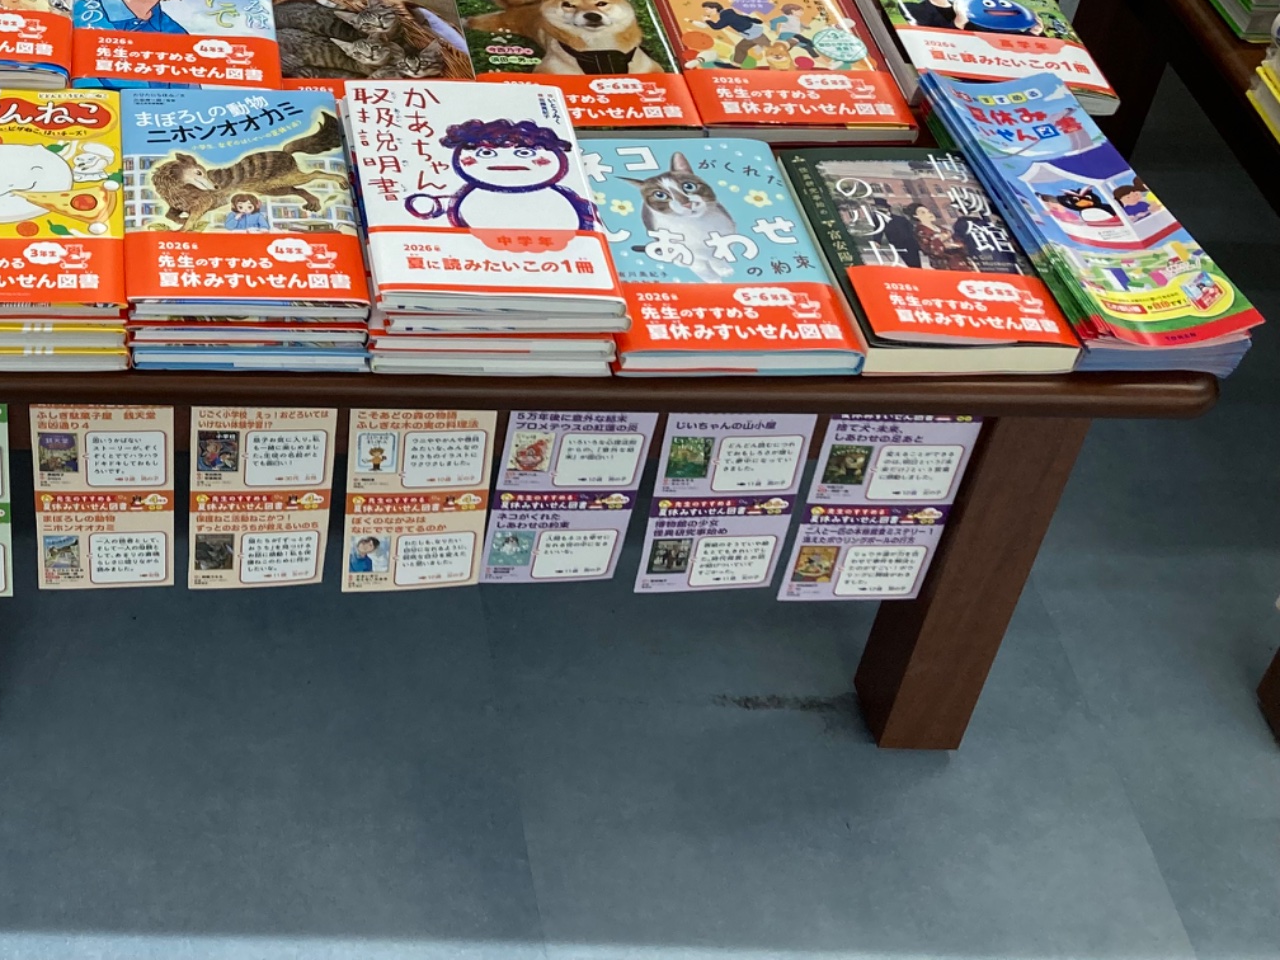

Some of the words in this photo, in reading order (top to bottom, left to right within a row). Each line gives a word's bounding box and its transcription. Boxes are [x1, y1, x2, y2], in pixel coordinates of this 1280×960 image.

[997, 39, 1049, 50] 高学年
[96, 46, 198, 63] 先生のすすめる
[930, 50, 1090, 74] 夏に読みたいこの1冊
[95, 60, 264, 82] 夏休みすいせん図書
[716, 87, 821, 100] 先生のすすめる
[133, 96, 270, 129] まぼろしの動物
[722, 100, 895, 117] 夏休みすいせん図書
[146, 101, 304, 145] ニホンオオカミ
[353, 89, 403, 202] 取扱説明書
[403, 87, 449, 188] かあちゃん
[698, 159, 784, 187] がくれた
[928, 153, 1016, 253] 博物館
[836, 178, 908, 268] の少女
[403, 243, 442, 253] 2026年
[496, 235, 554, 248] 中学年
[158, 254, 274, 269] 先生のすすめる
[405, 256, 595, 275] 夏に読みたいこの1冊
[747, 255, 816, 276] の約束
[159, 271, 352, 290] 夏休みすいせん図書
[641, 305, 760, 320] 先生のすすめる
[889, 294, 982, 313] 先生のすすめる
[647, 321, 844, 341] 夏休みすいせん図書
[896, 309, 1061, 336] 夏休みすいせん図書
[675, 420, 778, 431] じいちゃんの山小屋
[43, 514, 116, 524] まぼろしの動物
[351, 516, 427, 525] ぼくのなかみは
[496, 512, 561, 523] ネコがくれた
[496, 520, 571, 530] しあわせの約束
[43, 522, 116, 532] ニホンオオカミ
[351, 523, 447, 534] なにでできてるのか
